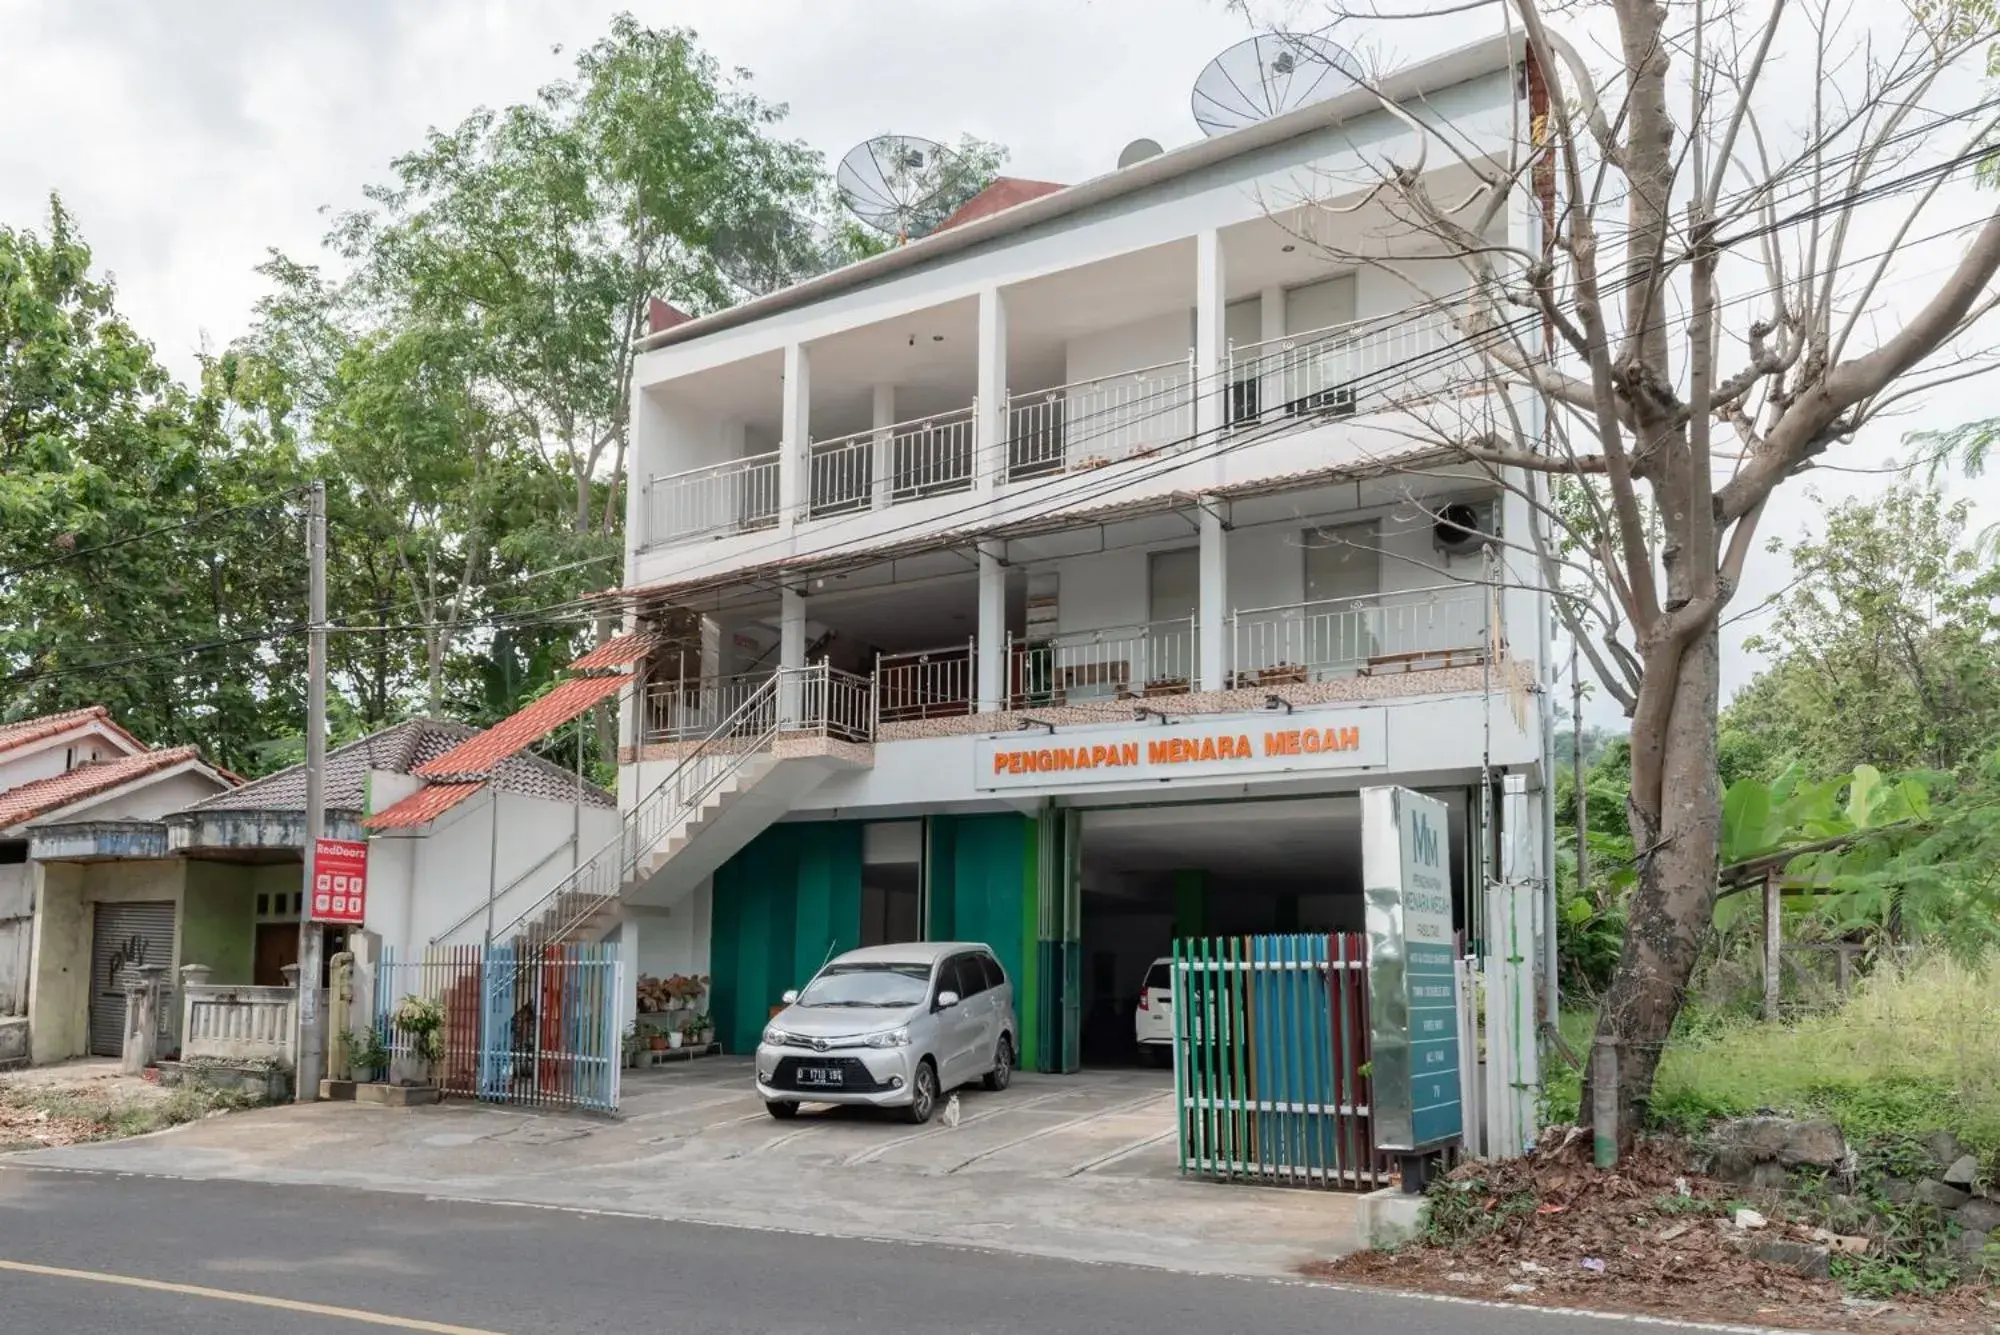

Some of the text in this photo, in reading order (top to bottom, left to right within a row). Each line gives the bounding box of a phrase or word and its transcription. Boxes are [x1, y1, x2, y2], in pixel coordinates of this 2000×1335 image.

[993, 726, 1360, 776] PENGINAPAN MENARA MEGAH
[317, 843, 365, 858] RedDoorz
